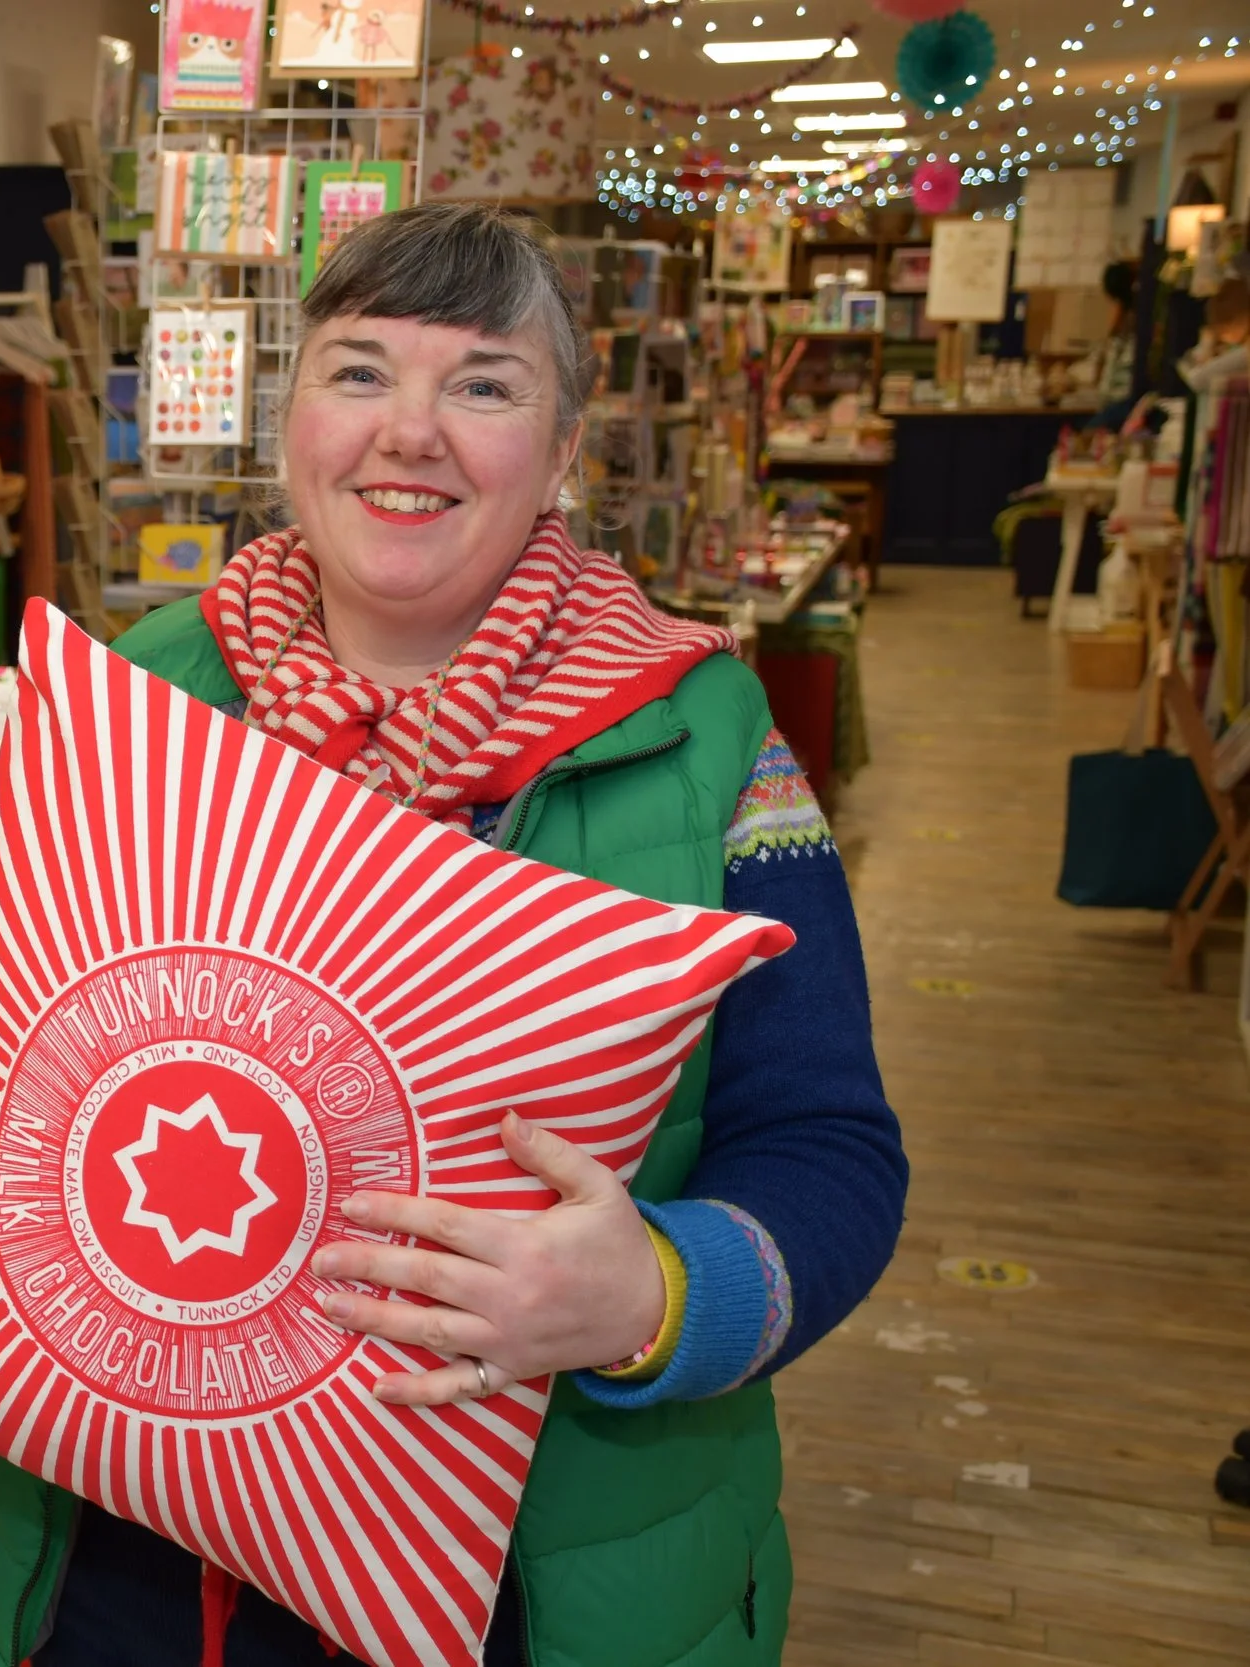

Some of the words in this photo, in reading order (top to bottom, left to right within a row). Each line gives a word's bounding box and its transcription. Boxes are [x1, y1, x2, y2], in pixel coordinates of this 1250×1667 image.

[62, 967, 334, 1068] TUNNOCK'S
[135, 1043, 176, 1069] MILK
[203, 1045, 292, 1104] SCOTLAND
[67, 1062, 131, 1160] CHOCOLATE
[65, 1166, 95, 1249] MALLOW
[296, 1123, 325, 1243] UDDINGSTON
[0, 1106, 47, 1232] MILK
[24, 1261, 290, 1398] CHOCOLATE
[89, 1251, 147, 1306] BISCUIT
[263, 1264, 293, 1295] LTD
[177, 1289, 265, 1321] TUNNOCK
